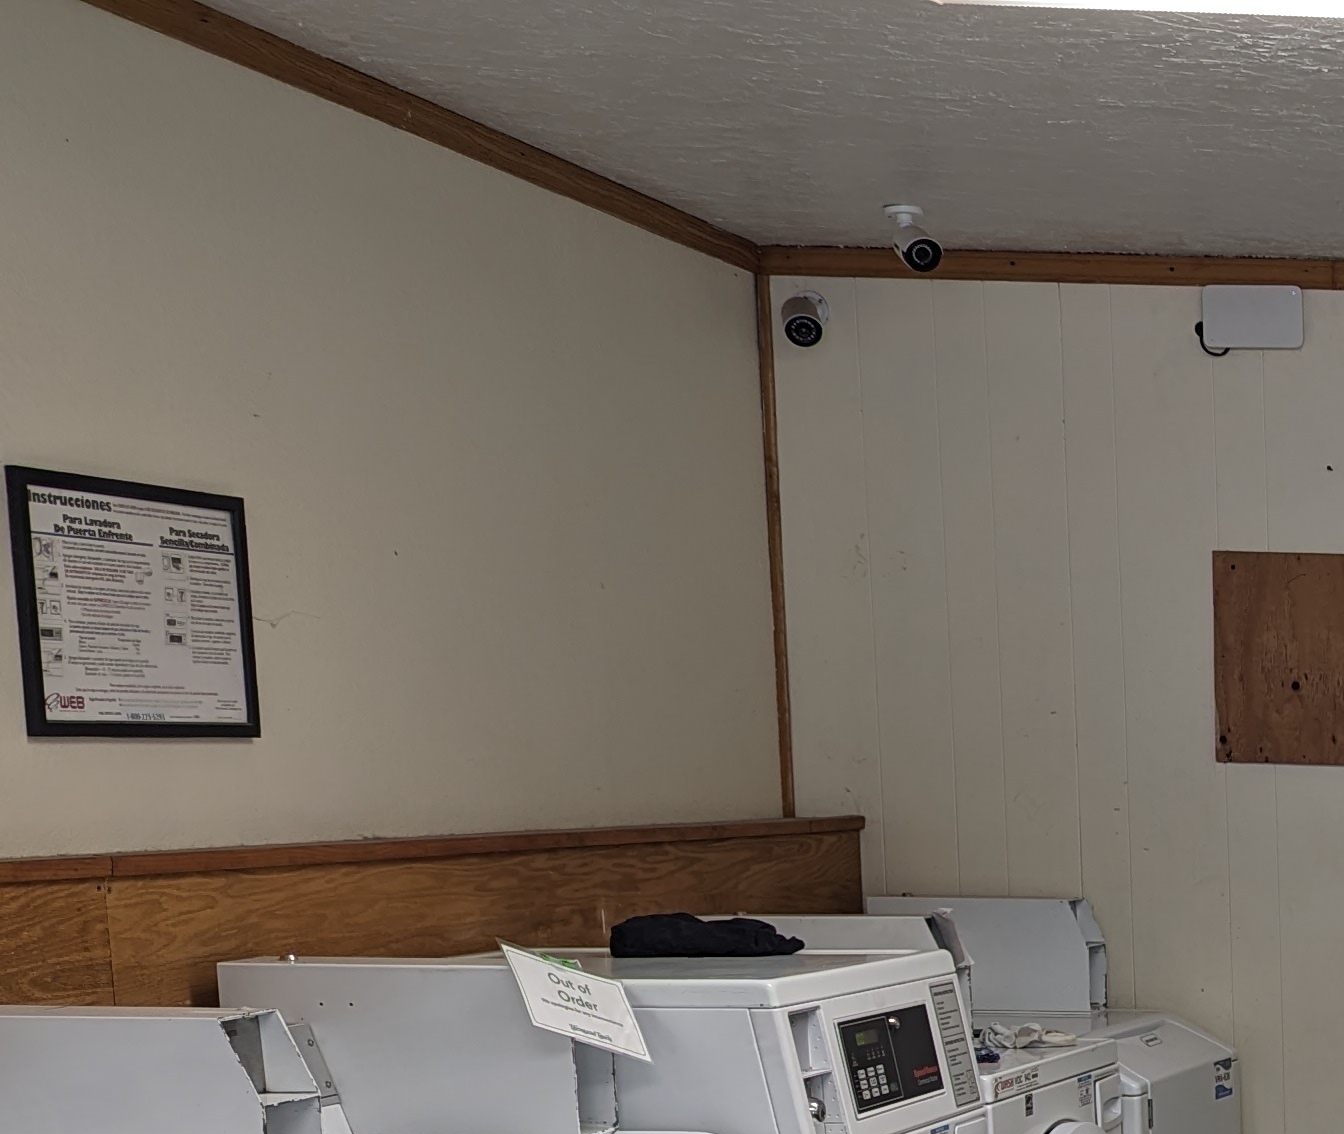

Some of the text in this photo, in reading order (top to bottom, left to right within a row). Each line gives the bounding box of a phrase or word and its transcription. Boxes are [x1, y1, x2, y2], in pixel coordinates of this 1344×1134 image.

[547, 972, 592, 996] Out of
[557, 990, 598, 1012] Order
